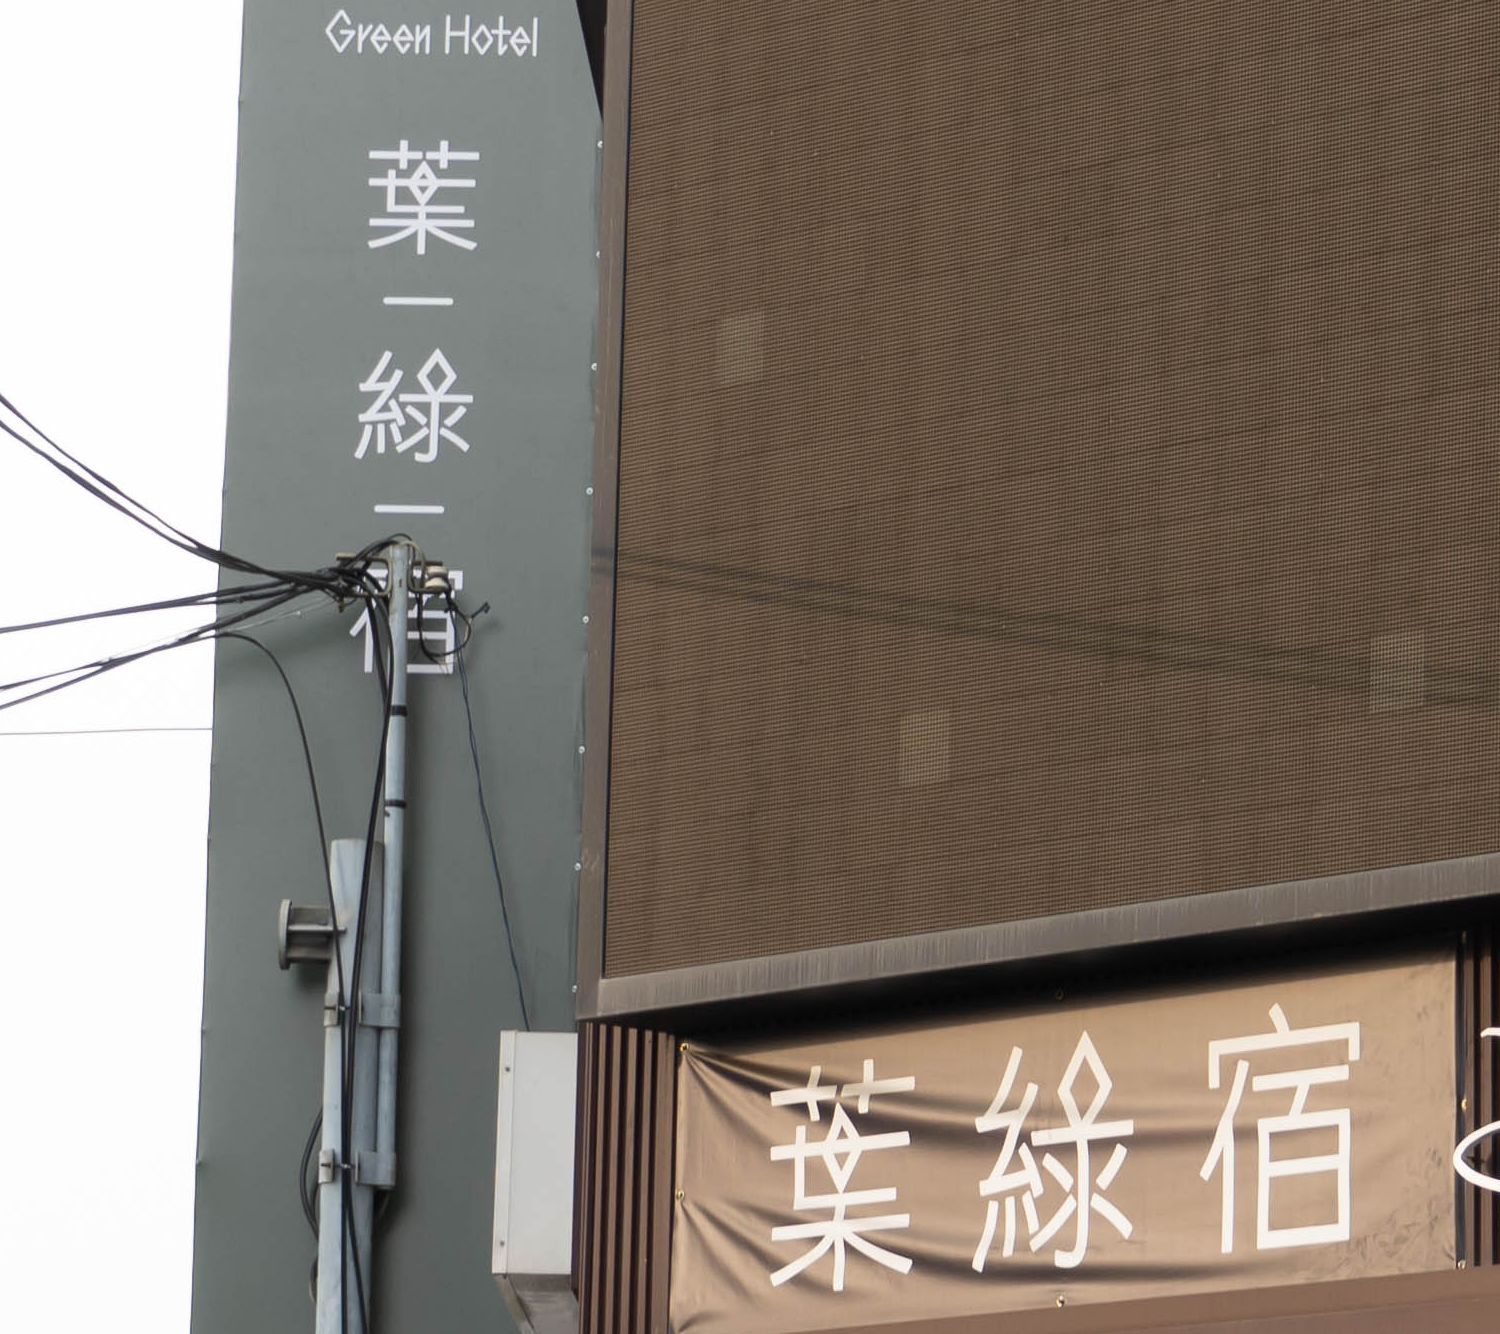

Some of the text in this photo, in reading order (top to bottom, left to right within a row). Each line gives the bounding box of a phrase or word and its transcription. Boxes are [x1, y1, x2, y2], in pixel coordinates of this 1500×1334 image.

[325, 9, 539, 57] Green Hotel
[768, 1003, 1361, 1293] 葉綠宿
